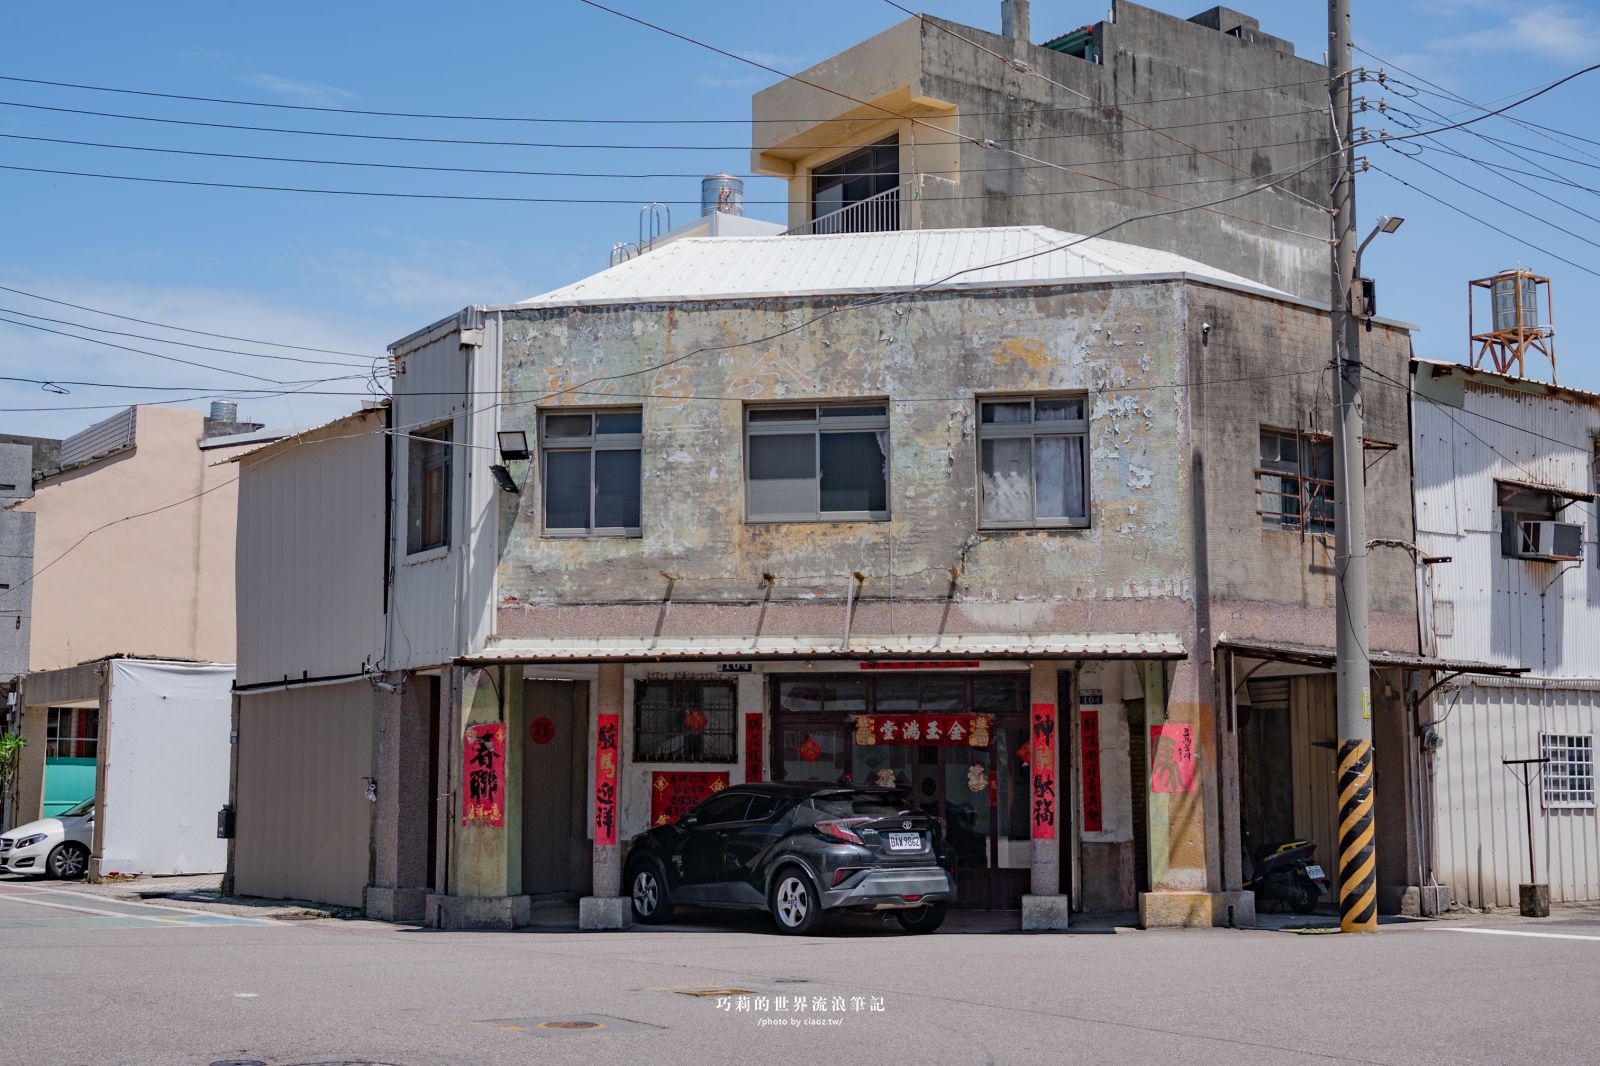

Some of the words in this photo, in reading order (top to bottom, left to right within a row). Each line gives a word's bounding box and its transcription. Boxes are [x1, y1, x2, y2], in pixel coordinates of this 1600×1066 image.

[597, 722, 617, 839] 駿馬迎祥
[879, 720, 967, 741] 金玉滿堂
[1033, 714, 1055, 827] 神駒馱福
